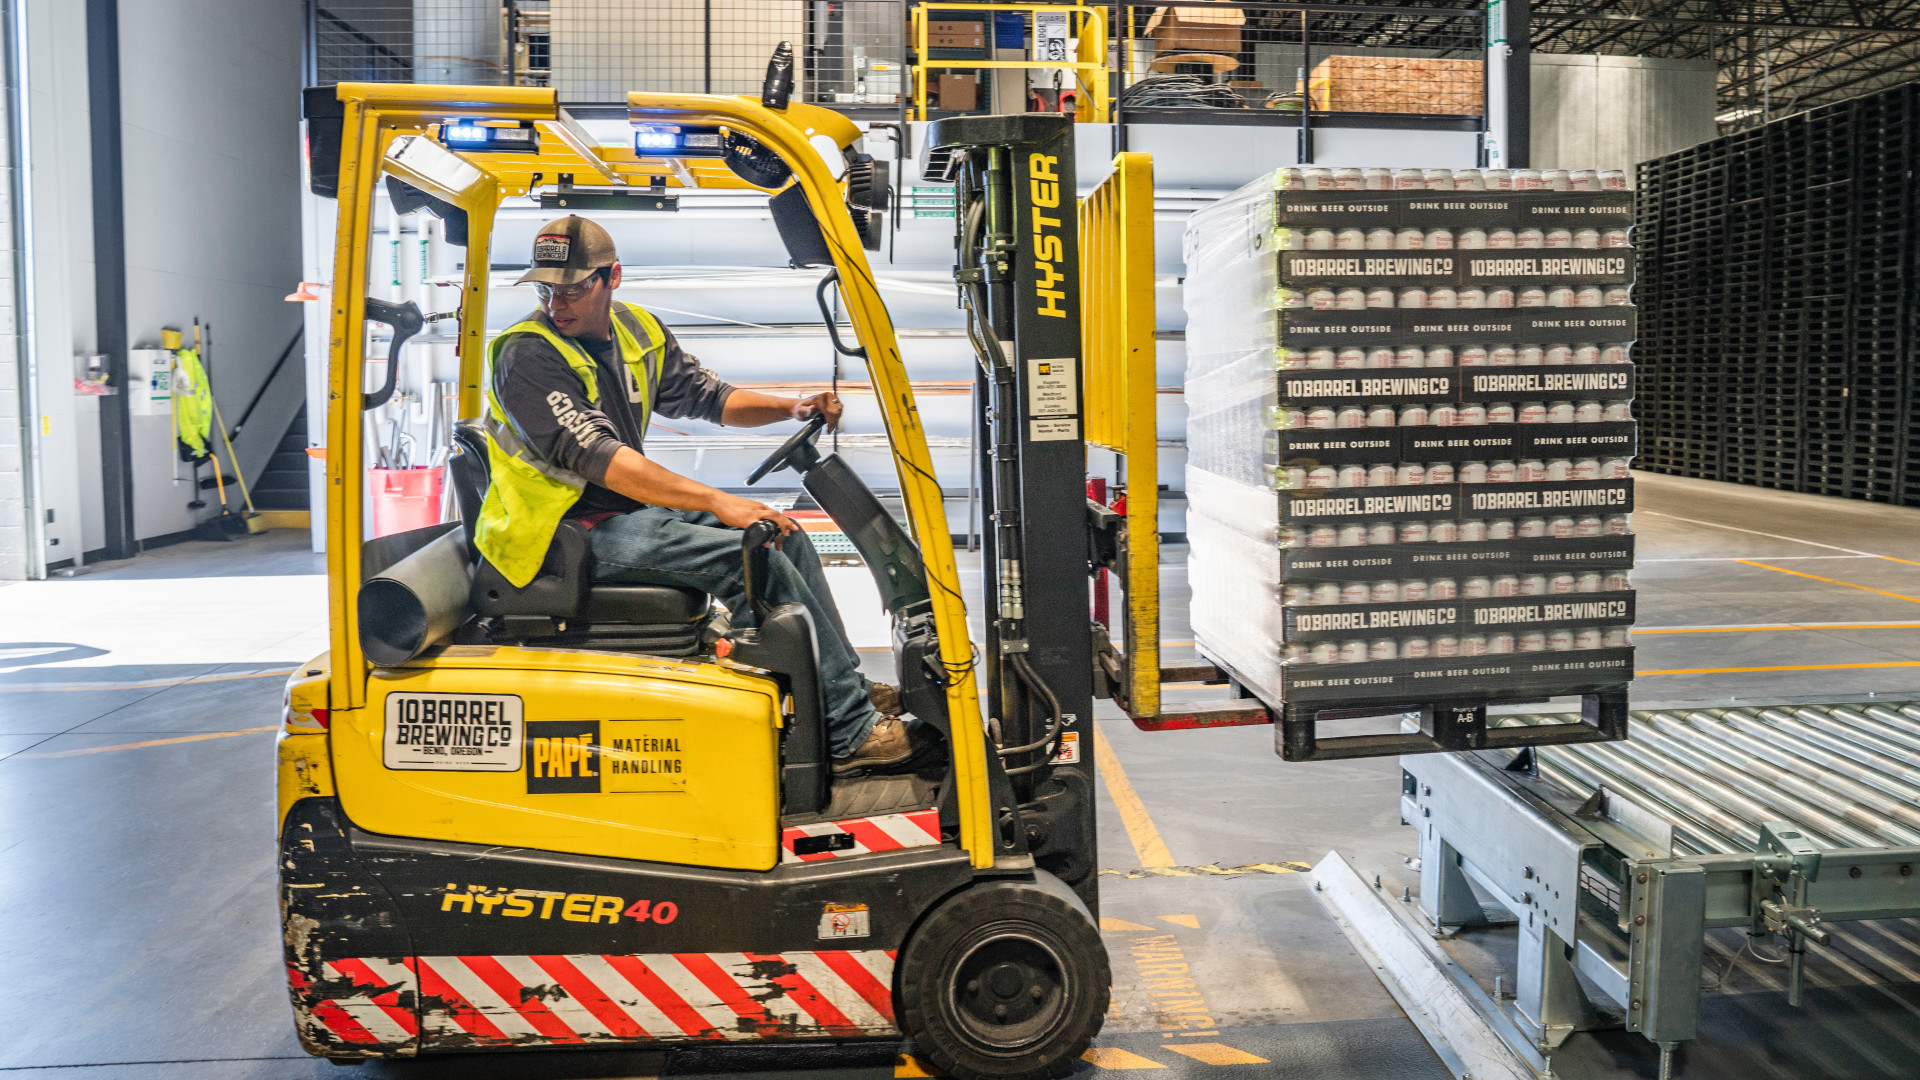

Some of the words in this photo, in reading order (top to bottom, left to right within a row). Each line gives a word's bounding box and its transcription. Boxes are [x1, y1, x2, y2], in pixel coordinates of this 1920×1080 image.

[1038, 24, 1046, 47] LEDGE
[1029, 152, 1066, 318] HYSTER
[1350, 440, 1390, 448] OUTSIDE
[1473, 438, 1512, 446] OUTSIDE
[1590, 551, 1626, 559] OUTSIDE
[1292, 561, 1323, 569] DRINK
[1352, 558, 1392, 566] OUTSIDE
[1472, 667, 1510, 675] OUTSIDE
[1532, 664, 1560, 672] DRINK
[1588, 660, 1625, 668] OUTSIDE
[1293, 680, 1324, 688] DRINK
[1354, 676, 1393, 685] OUTSIDE
[1457, 713, 1474, 723] A-B
[613, 738, 681, 752] MATERIAL
[423, 747, 448, 756] BEND,
[450, 747, 483, 756] OREGON
[533, 733, 593, 778] PAPÉ
[612, 759, 682, 774] HANDLING
[624, 900, 678, 924] 40
[1128, 934, 1220, 1038] WARNING!
